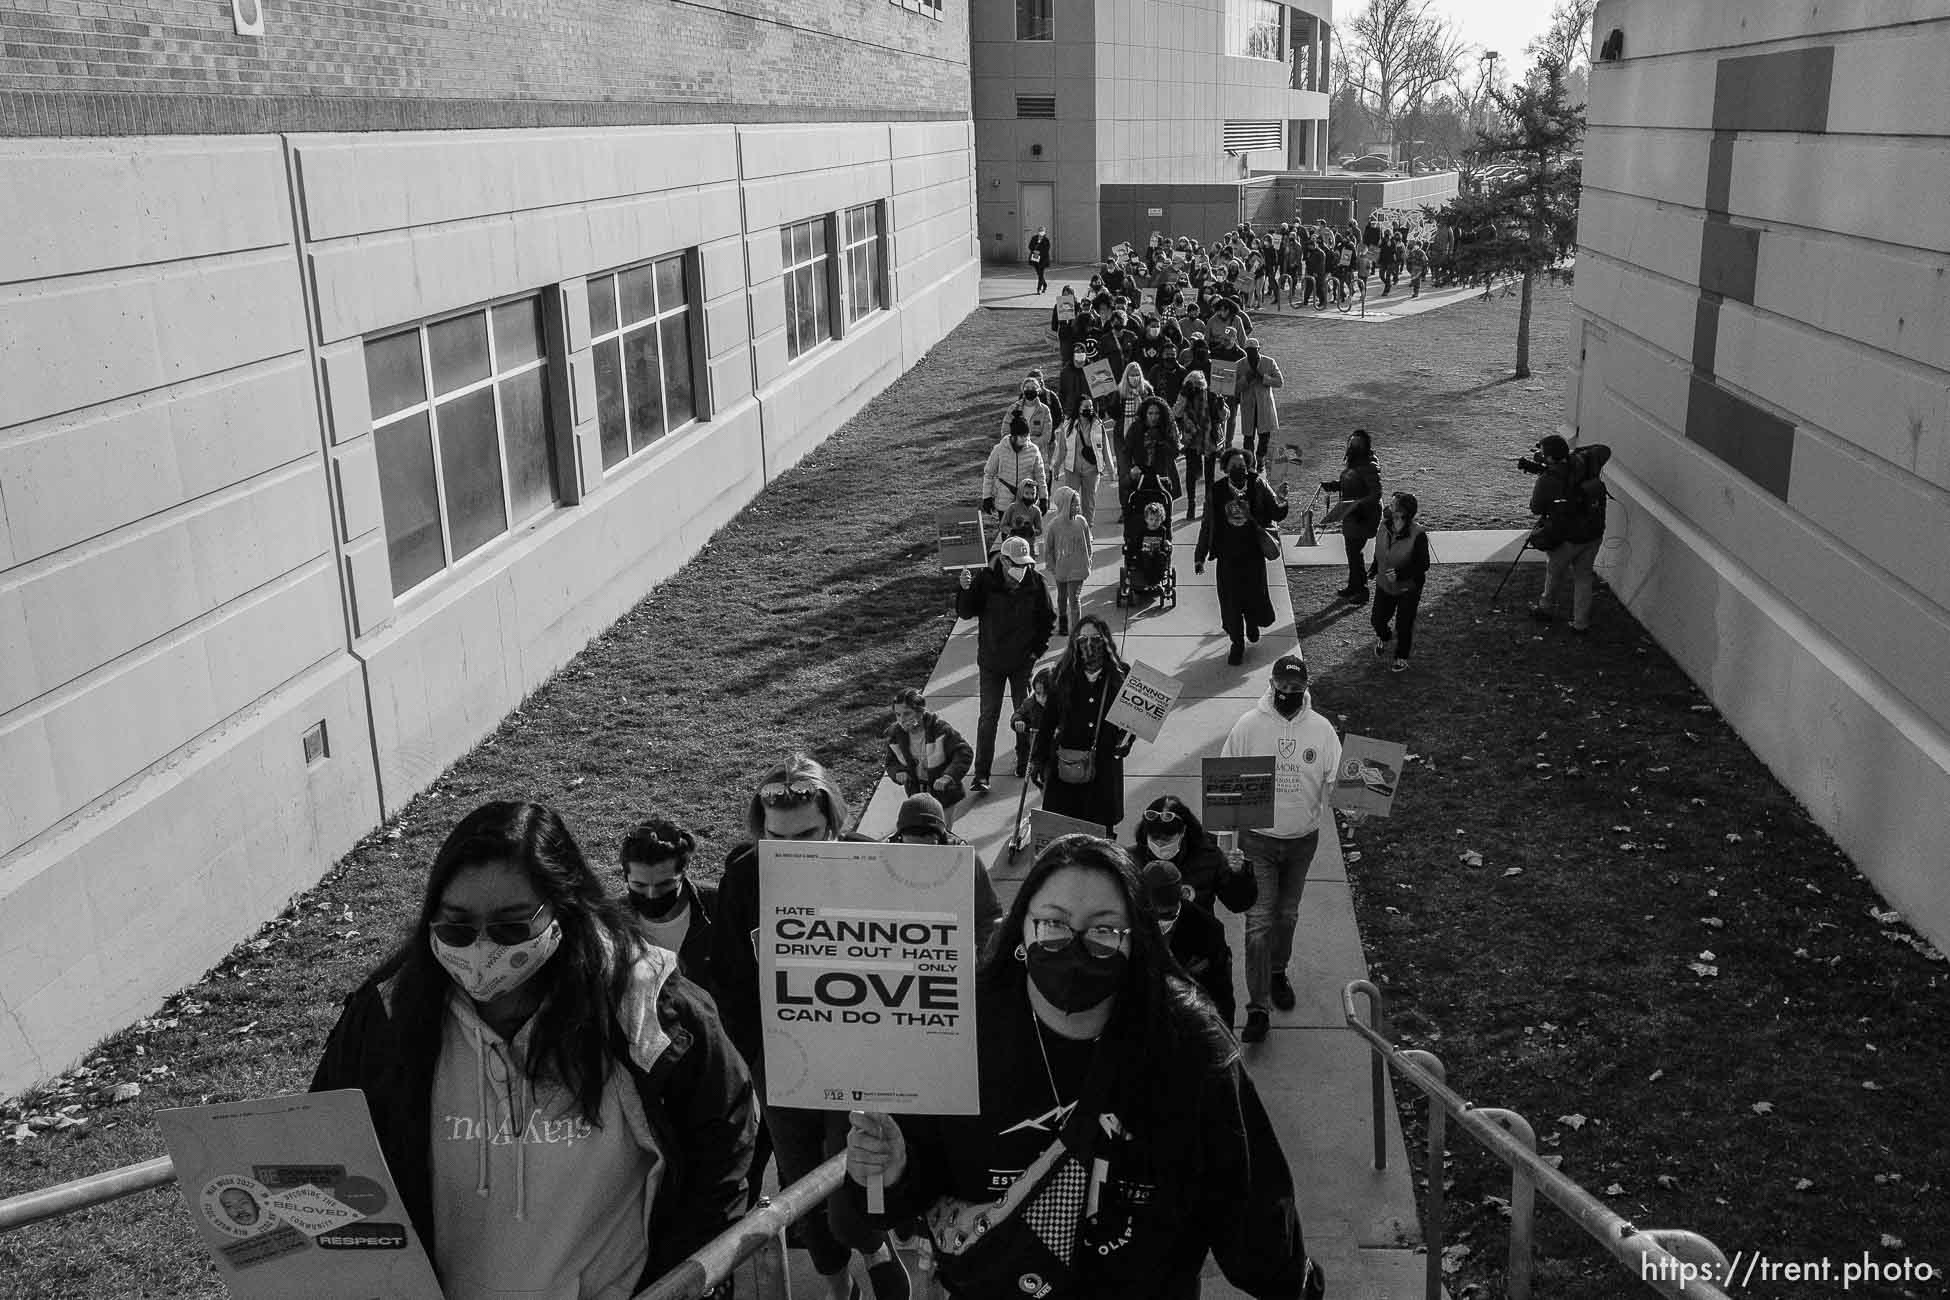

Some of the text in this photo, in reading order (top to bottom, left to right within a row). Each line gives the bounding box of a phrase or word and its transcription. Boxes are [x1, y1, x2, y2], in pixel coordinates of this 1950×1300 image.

[1129, 678, 1171, 702] CANNOT
[1121, 690, 1165, 718] LOVE
[1276, 763, 1300, 772] MORY
[775, 906, 815, 916] HATE
[775, 918, 958, 946] CANNOT
[775, 943, 958, 961] DRIVE OUT HATE
[918, 963, 958, 972] ONLY
[775, 970, 959, 1010] LOVE
[777, 1008, 959, 1027] CAN DO THAT
[274, 1201, 348, 1217] BELOVED
[319, 1235, 404, 1247] RESPECT
